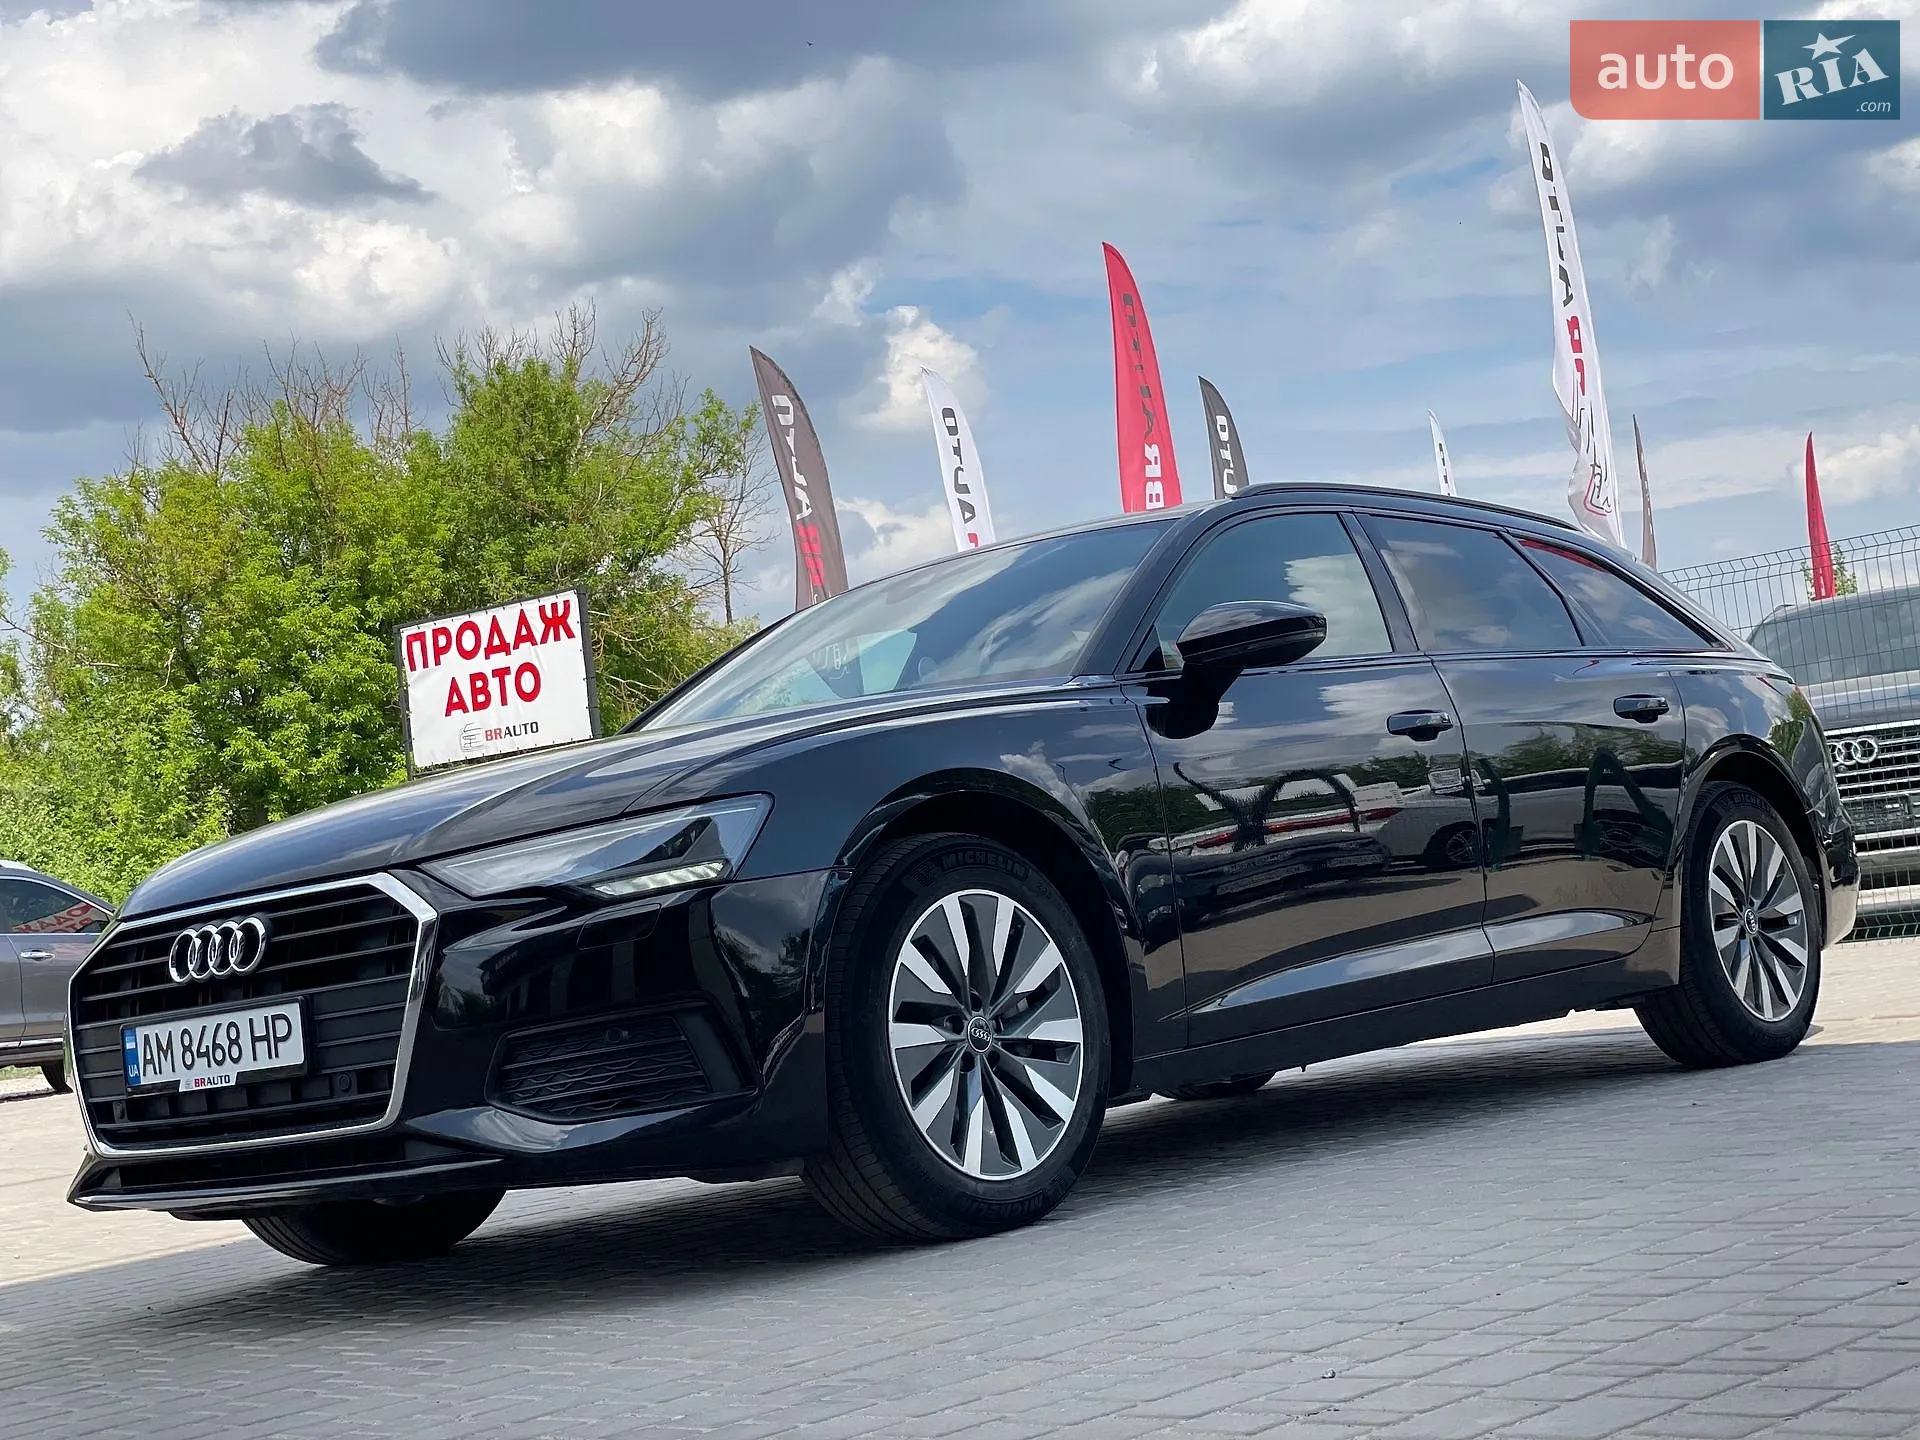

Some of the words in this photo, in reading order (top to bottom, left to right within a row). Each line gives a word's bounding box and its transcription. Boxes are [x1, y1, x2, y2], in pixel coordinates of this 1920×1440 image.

[406, 599, 576, 672] ПРОДАЖ
[445, 661, 542, 718] АВТО
[485, 721, 539, 742] BRAUTO
[143, 1030, 176, 1077] AM
[180, 1020, 242, 1071] 8468
[249, 1012, 292, 1062] HP
[128, 1063, 139, 1078] UA
[194, 1073, 231, 1088] BRAUTO
